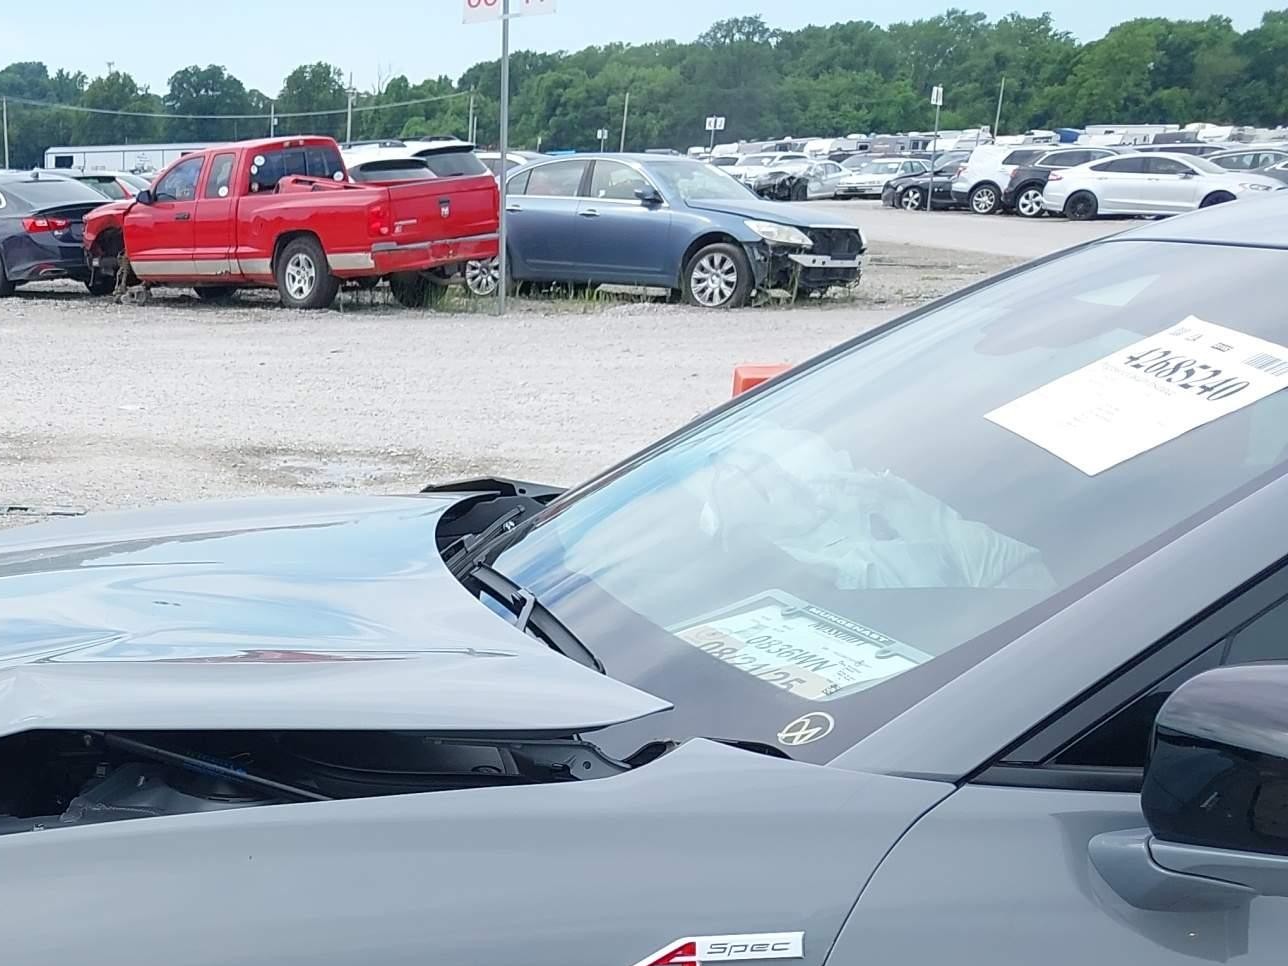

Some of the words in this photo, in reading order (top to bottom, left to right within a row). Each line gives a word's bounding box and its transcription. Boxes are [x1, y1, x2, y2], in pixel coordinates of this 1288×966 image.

[1123, 347, 1251, 401] 42685240
[808, 607, 889, 642] MUNGENAST
[699, 640, 807, 690] 08/21/25
[706, 942, 791, 956] Spec
